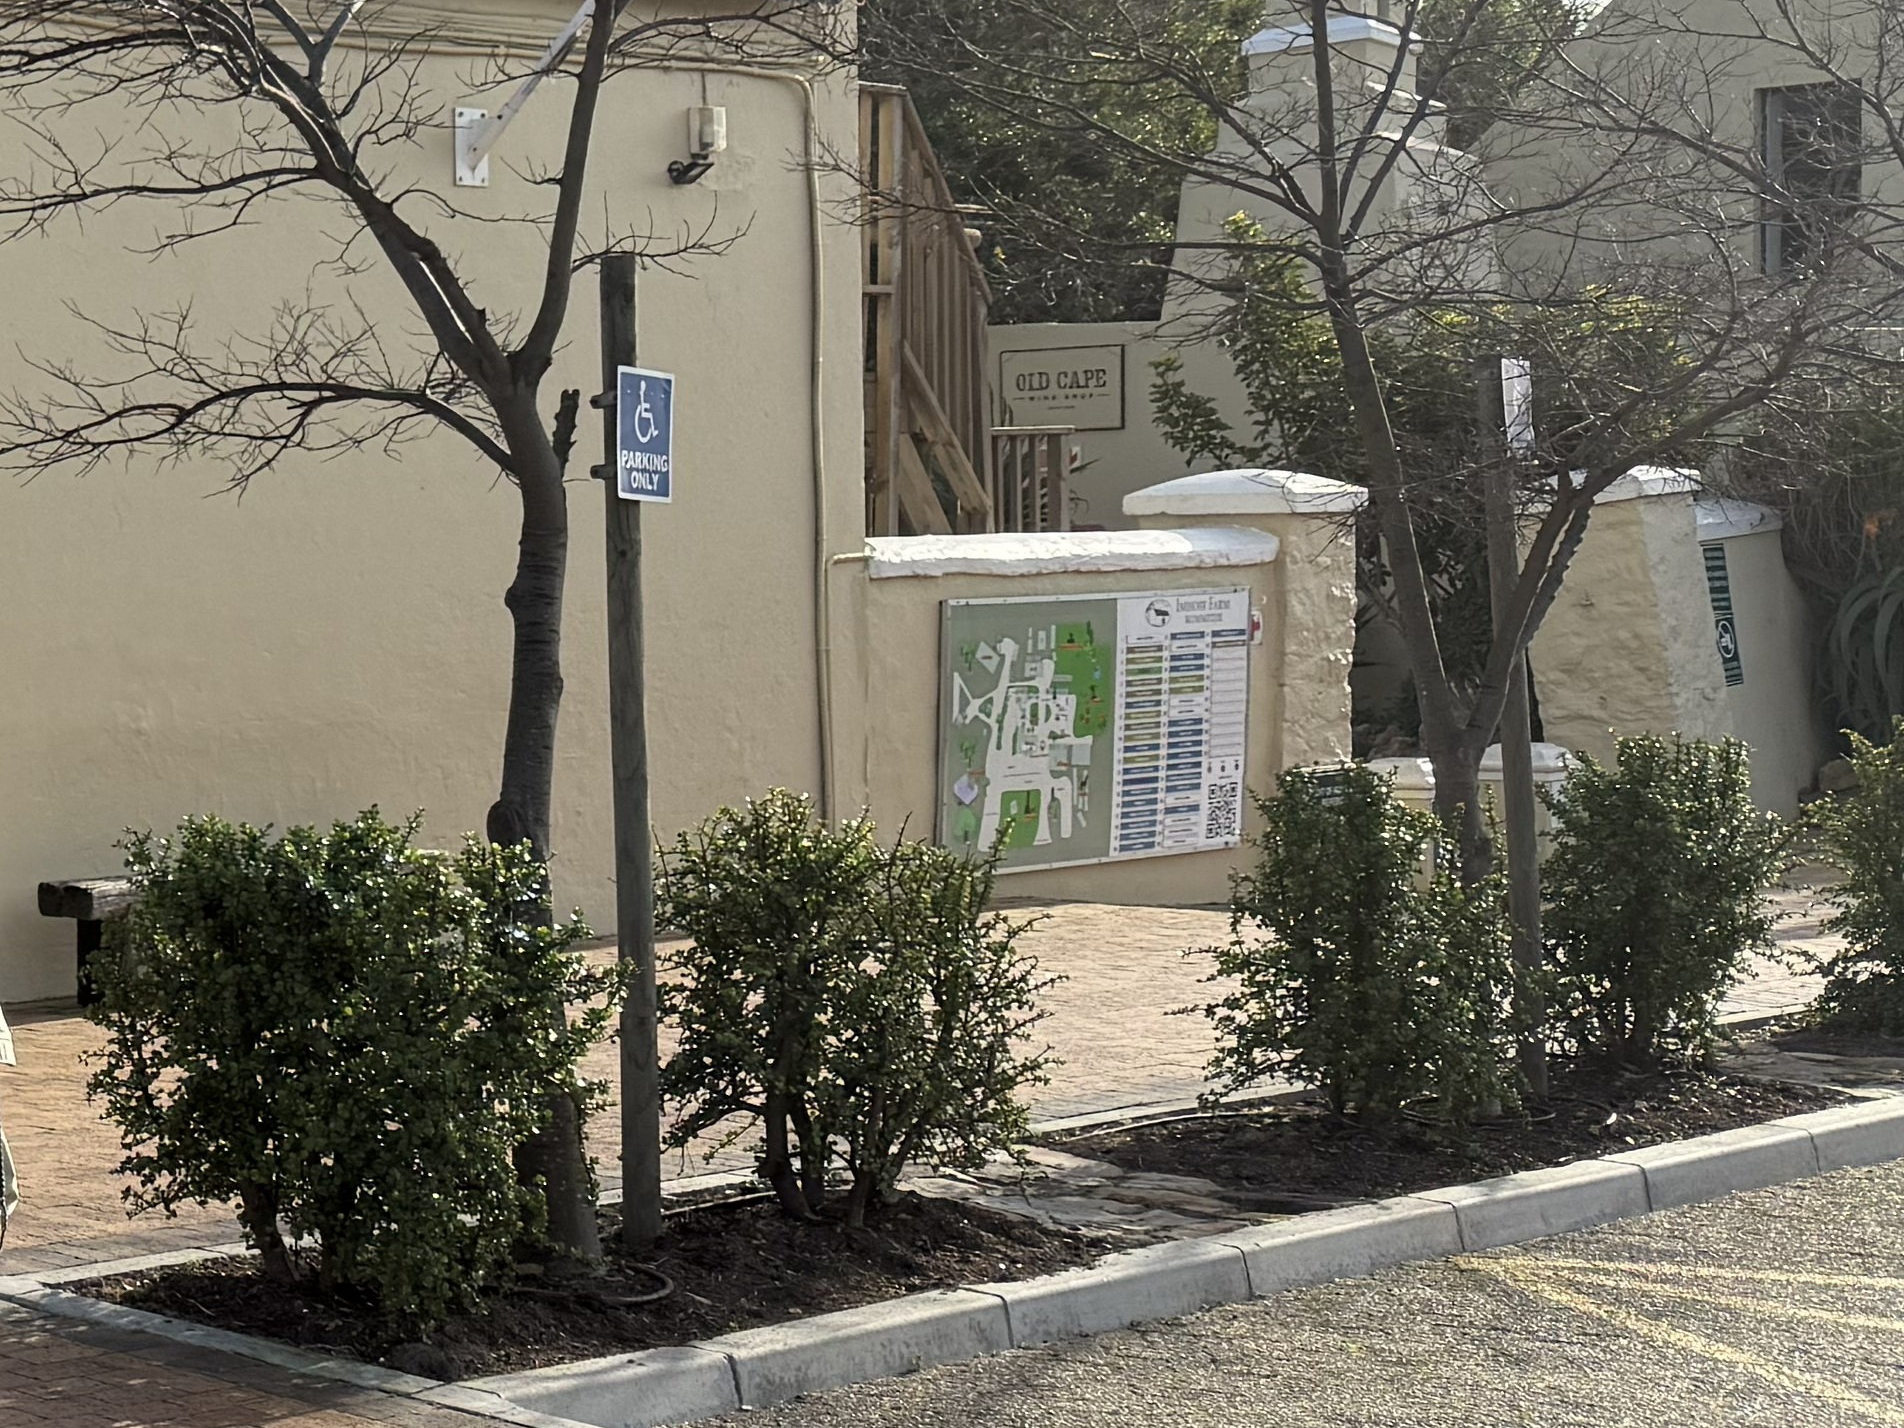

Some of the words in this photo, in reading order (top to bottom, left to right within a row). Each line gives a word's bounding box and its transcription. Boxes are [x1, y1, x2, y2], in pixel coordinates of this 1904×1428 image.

[1016, 371, 1050, 392] OLD
[1057, 368, 1107, 390] CAPE
[621, 450, 669, 473] PARKING
[630, 470, 660, 491] ONLY
